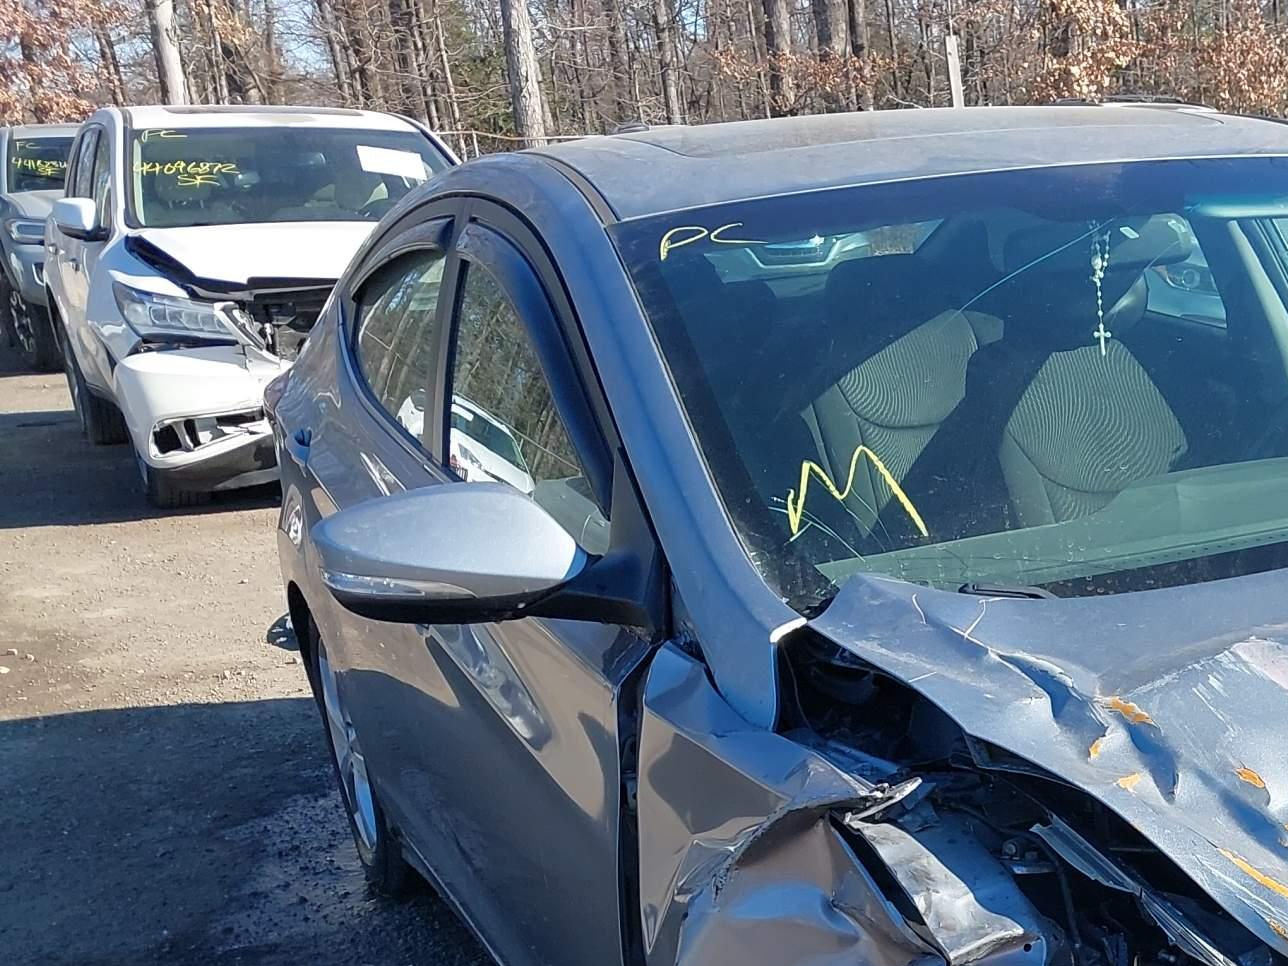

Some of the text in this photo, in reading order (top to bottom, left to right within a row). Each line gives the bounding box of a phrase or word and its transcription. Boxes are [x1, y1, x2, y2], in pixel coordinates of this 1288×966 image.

[133, 160, 240, 176] 44096872
[660, 222, 769, 261] PC
[786, 444, 929, 537] M
